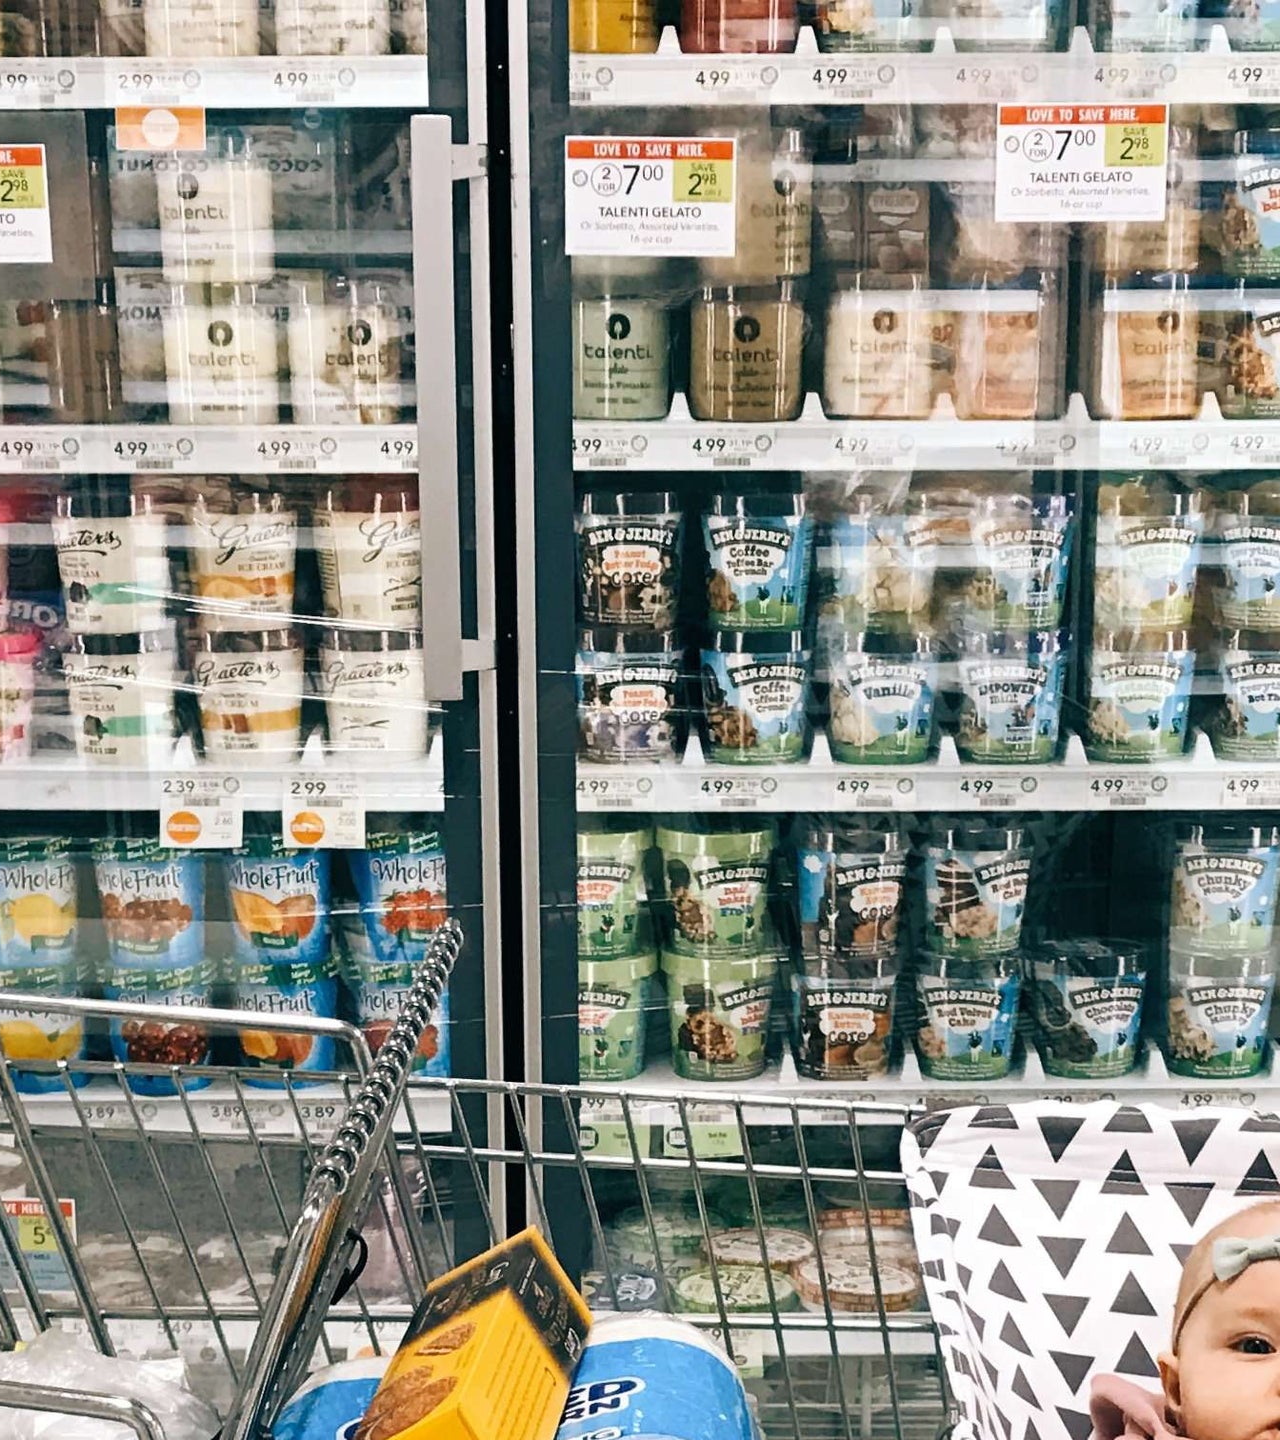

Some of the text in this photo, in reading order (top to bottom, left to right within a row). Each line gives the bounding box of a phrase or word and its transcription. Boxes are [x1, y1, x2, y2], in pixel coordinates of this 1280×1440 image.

[1026, 109, 1053, 122] LOVE
[1059, 109, 1073, 121] TO
[1079, 109, 1104, 121] SAVE
[594, 143, 620, 156] LOVE
[626, 143, 640, 156] TO
[646, 143, 672, 156] SAVE
[1030, 172, 1132, 183] TALENTI GELATO
[599, 207, 701, 218] TALENTI GELATO
[730, 547, 770, 557] Coffee
[1197, 875, 1252, 891] Chunky
